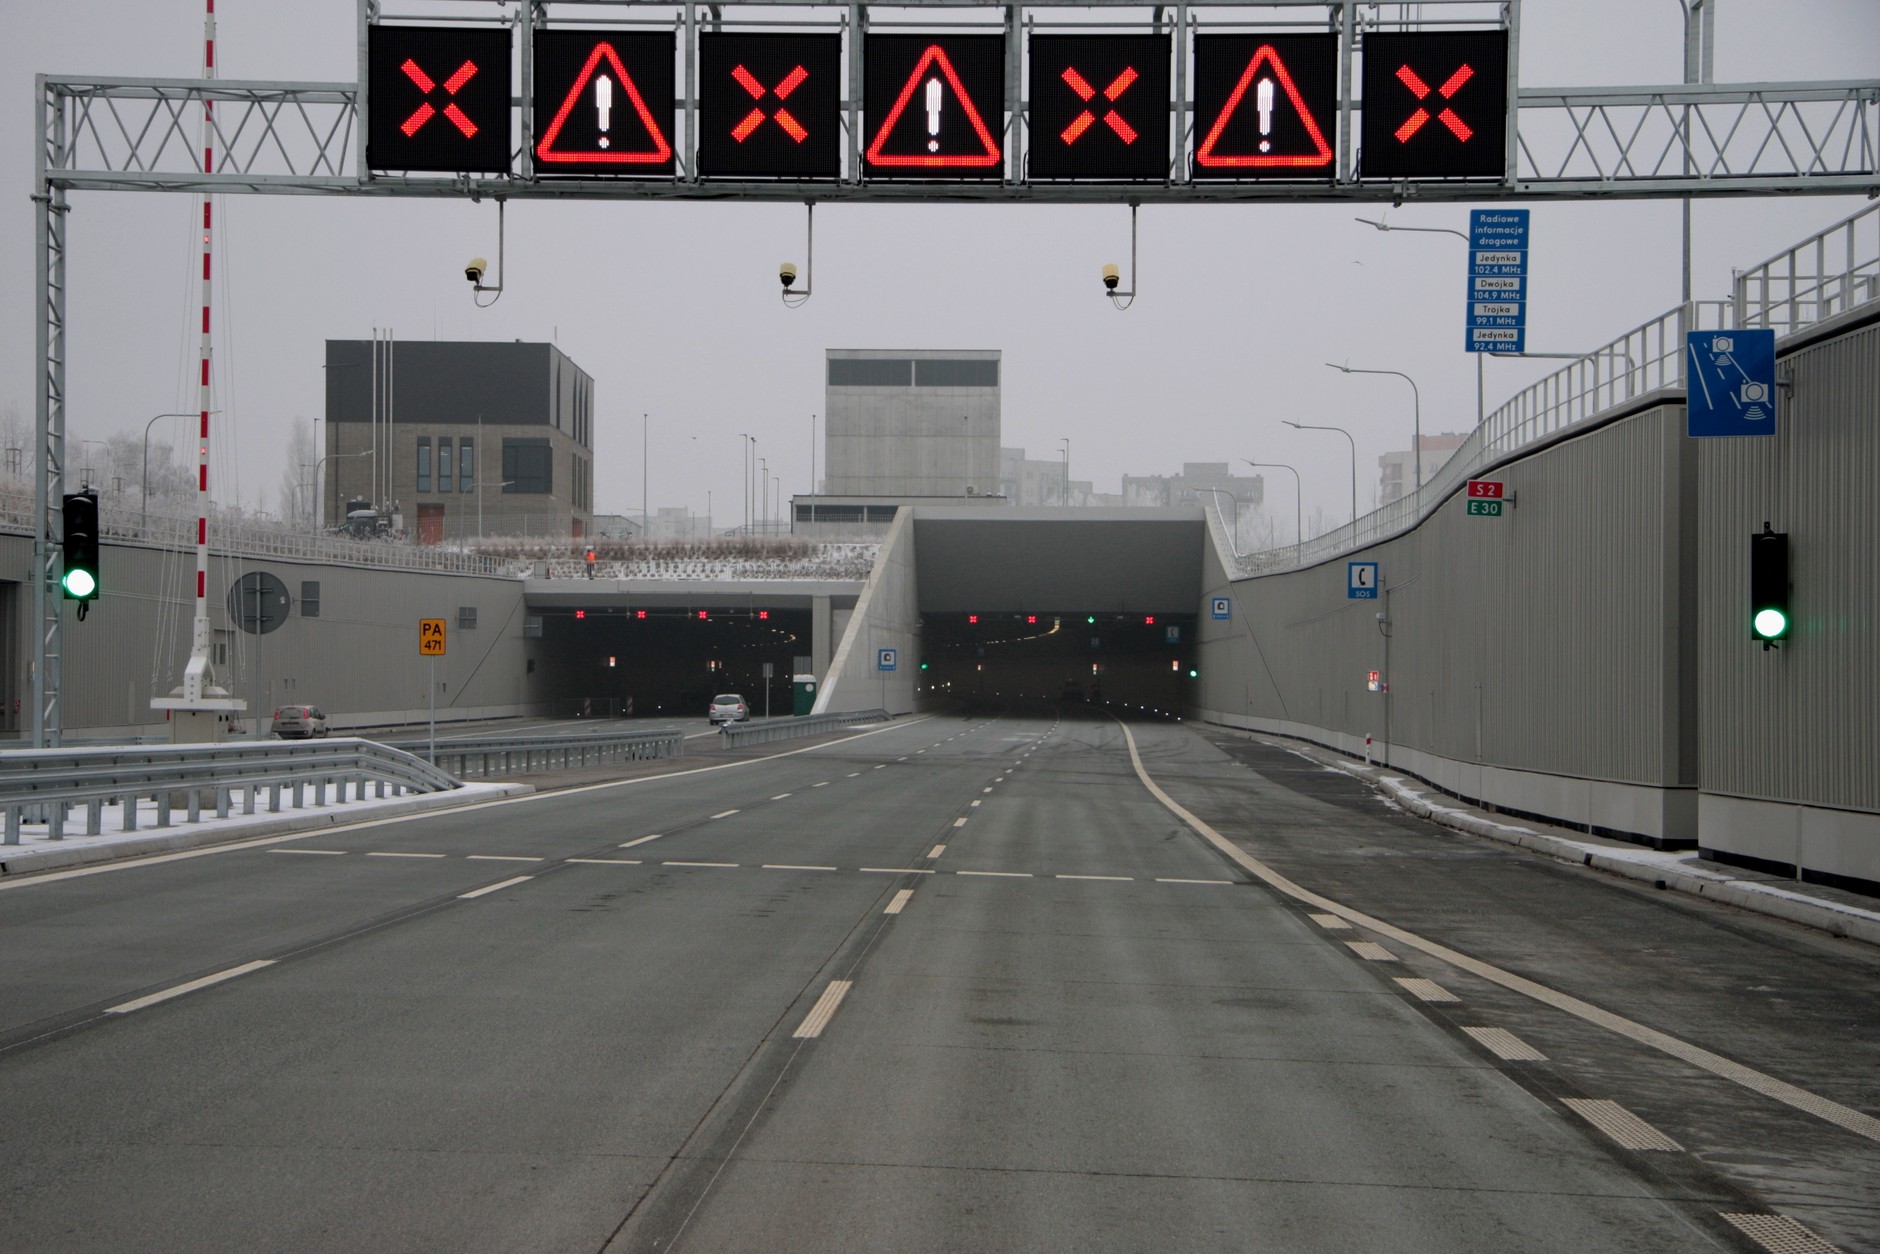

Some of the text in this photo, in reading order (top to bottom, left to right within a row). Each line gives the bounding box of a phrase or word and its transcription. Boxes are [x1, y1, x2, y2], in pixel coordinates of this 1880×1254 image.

[1475, 226, 1523, 235] informacje
[1479, 237, 1519, 246] drogowe
[1480, 254, 1517, 263] Jedynka
[1496, 317, 1516, 325] MHz
[1477, 331, 1514, 340] Jedynka
[1476, 484, 1495, 496] S 2
[1471, 502, 1498, 514] E 30
[423, 623, 442, 636] PA
[424, 640, 441, 650] 471
